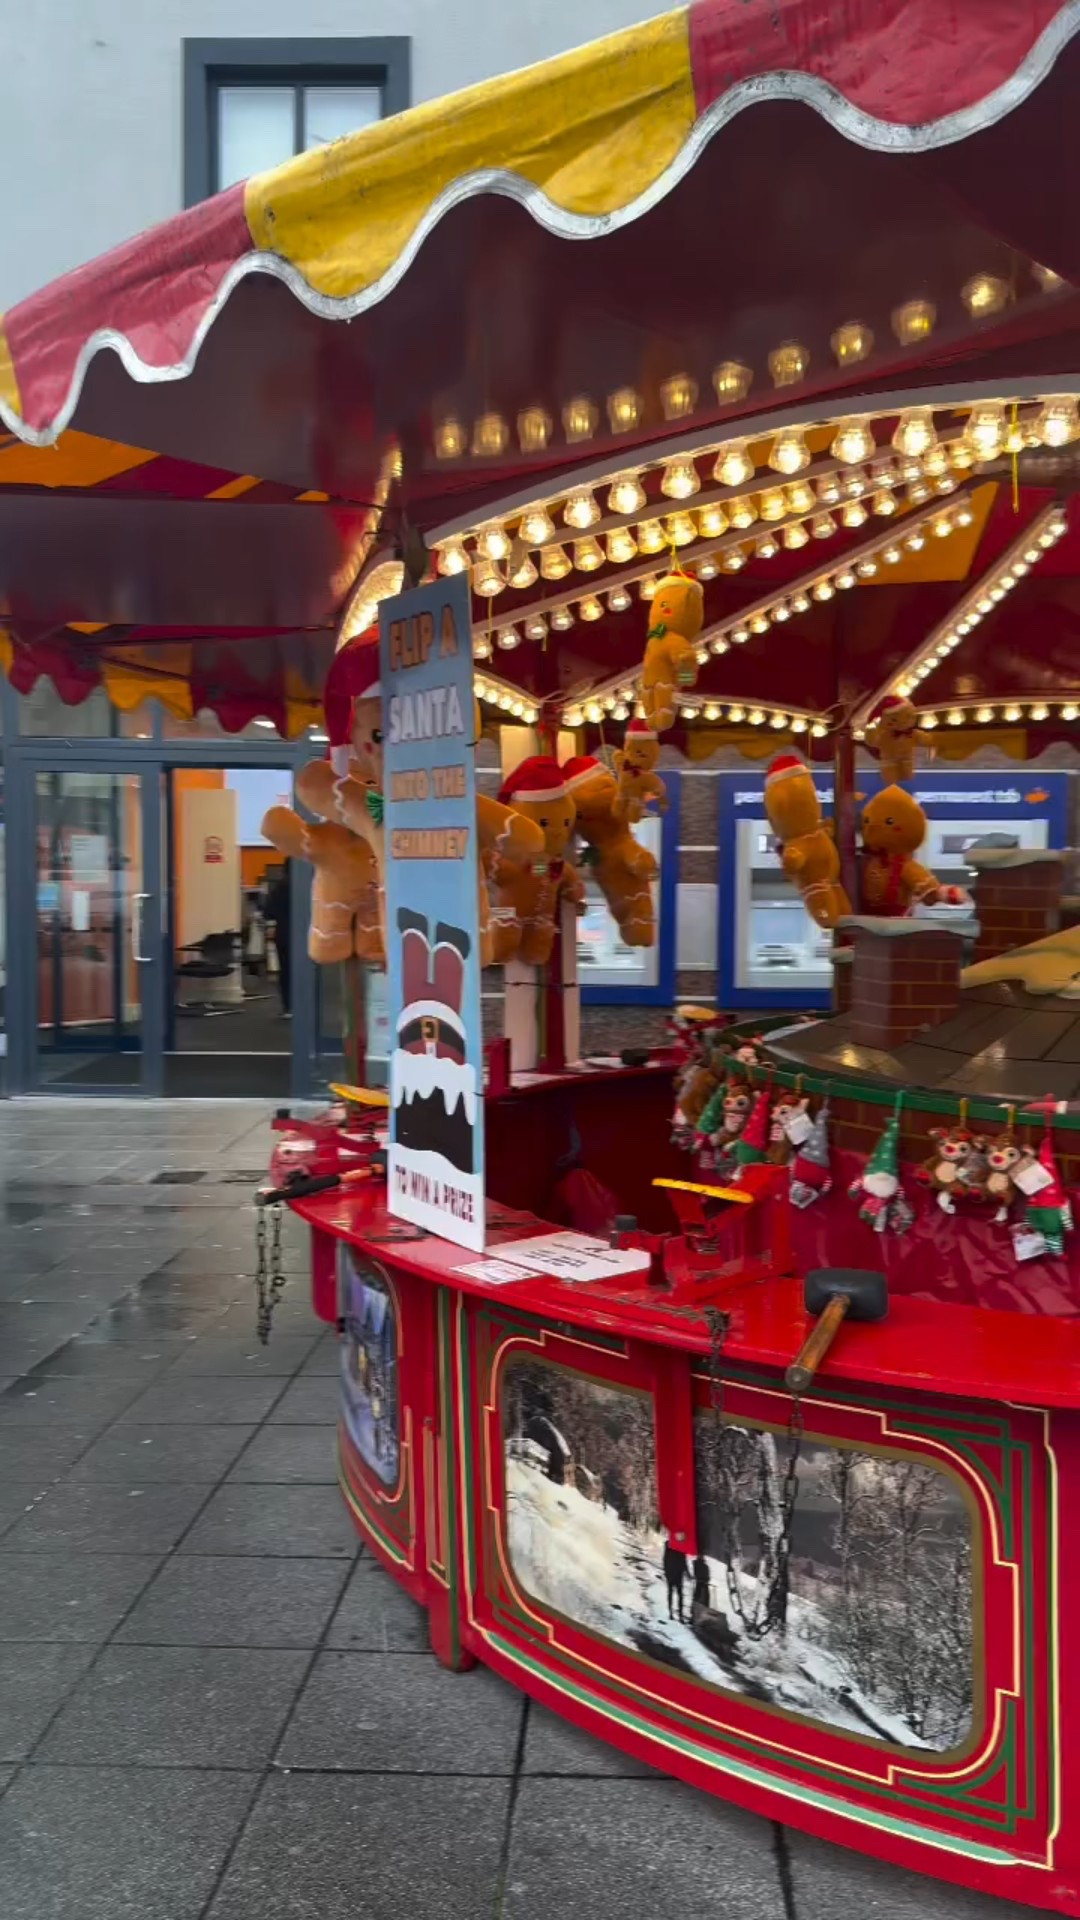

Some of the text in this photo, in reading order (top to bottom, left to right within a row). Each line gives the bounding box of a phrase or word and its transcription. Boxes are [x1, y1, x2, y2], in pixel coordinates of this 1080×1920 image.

[389, 603, 459, 672] FLIP A
[388, 682, 465, 745] SANTA
[390, 763, 466, 803] INTO THE
[394, 1164, 474, 1223] TO WIN A PRIZE
